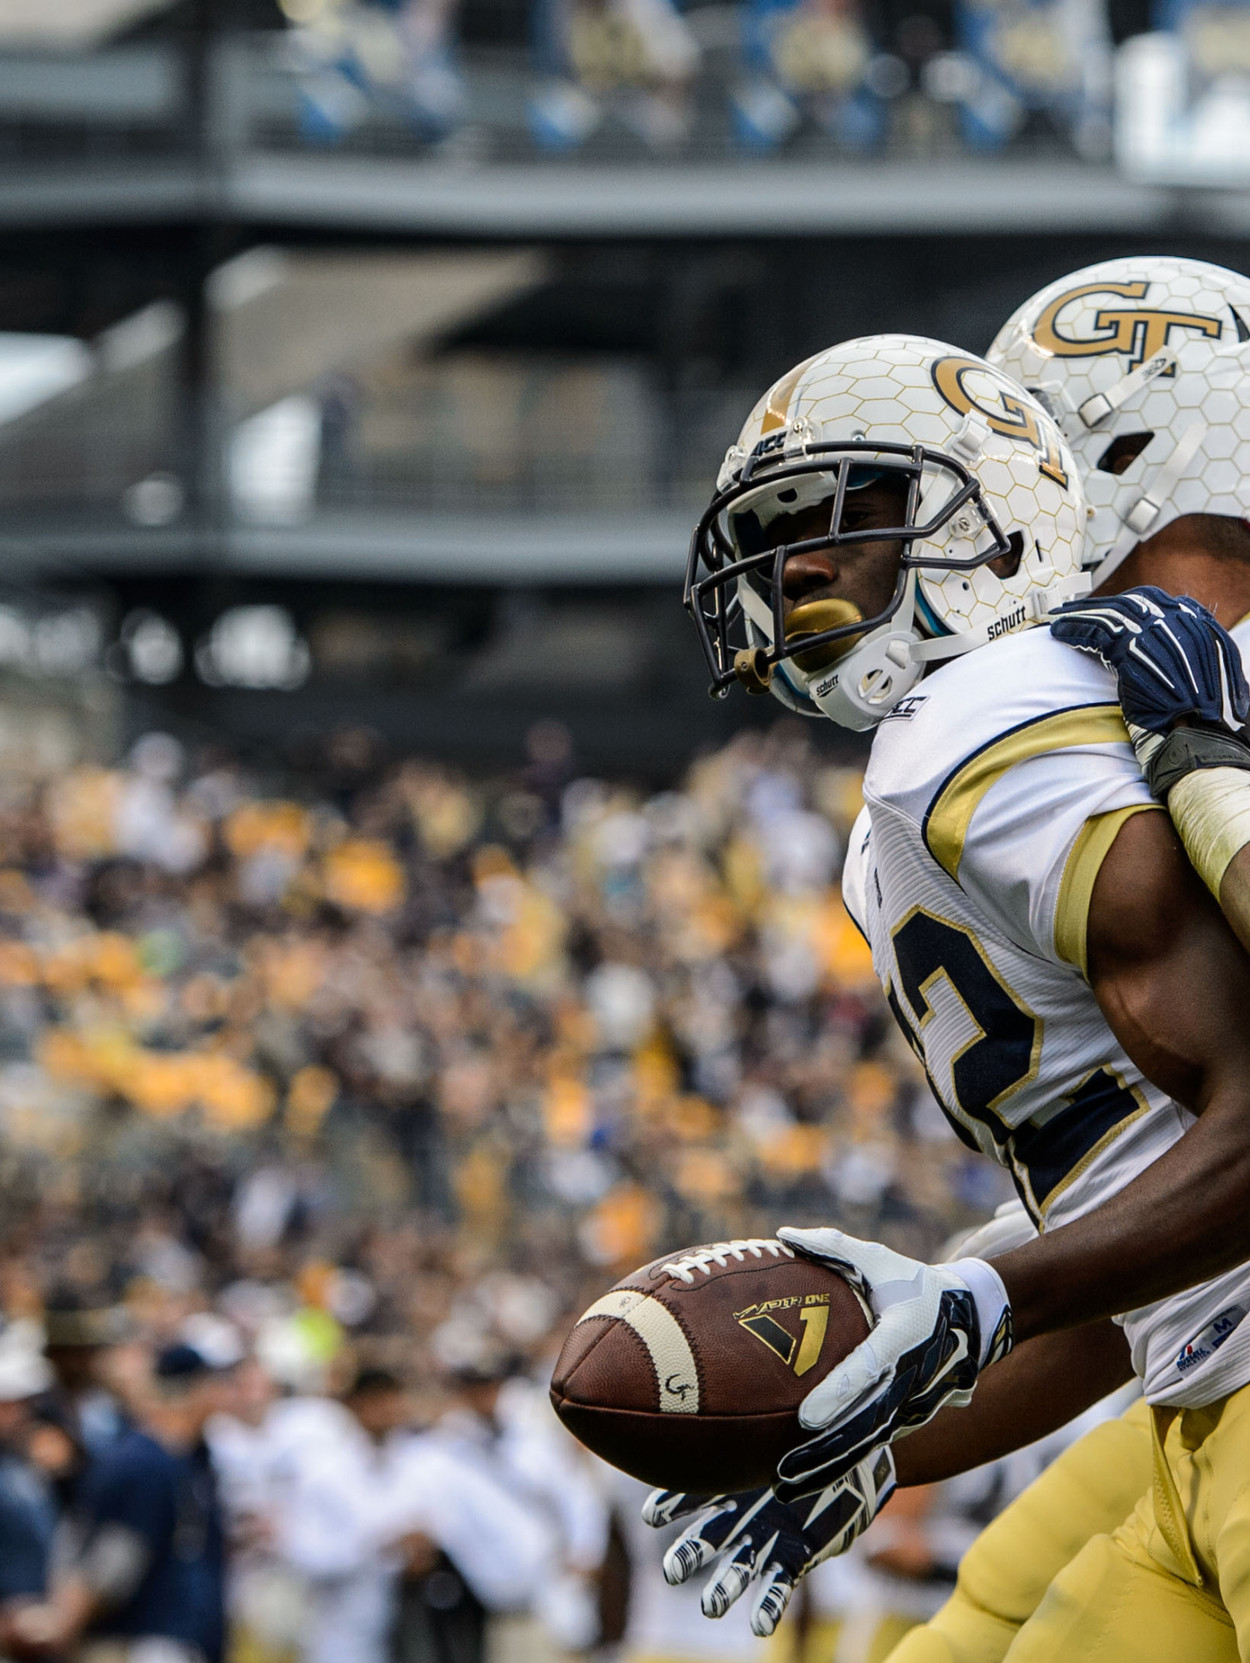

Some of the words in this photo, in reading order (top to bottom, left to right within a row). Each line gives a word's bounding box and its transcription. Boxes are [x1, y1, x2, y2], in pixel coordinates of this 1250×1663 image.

[1032, 281, 1223, 378] GT
[931, 356, 1069, 492] GT
[1213, 1318, 1233, 1334] M
